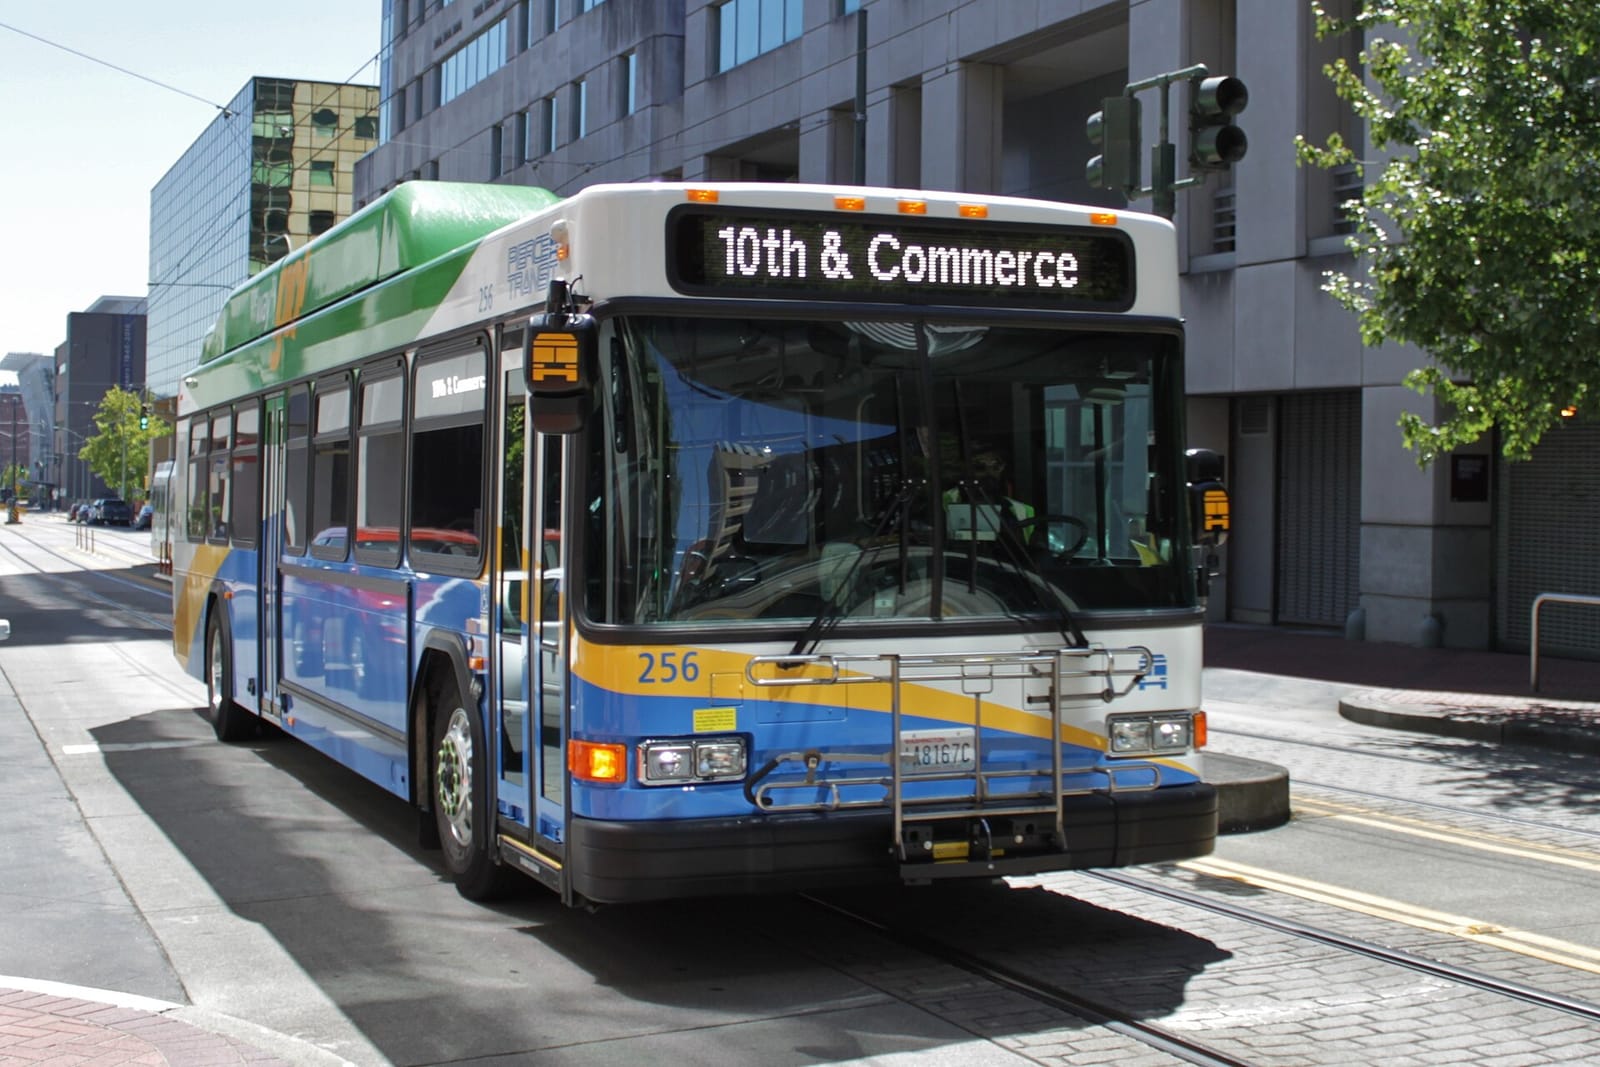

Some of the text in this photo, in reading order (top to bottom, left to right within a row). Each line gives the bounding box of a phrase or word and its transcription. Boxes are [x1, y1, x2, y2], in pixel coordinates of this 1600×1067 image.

[718, 227, 1079, 288] 10th & Commerce
[479, 284, 493, 313] 256
[638, 651, 700, 683] 256
